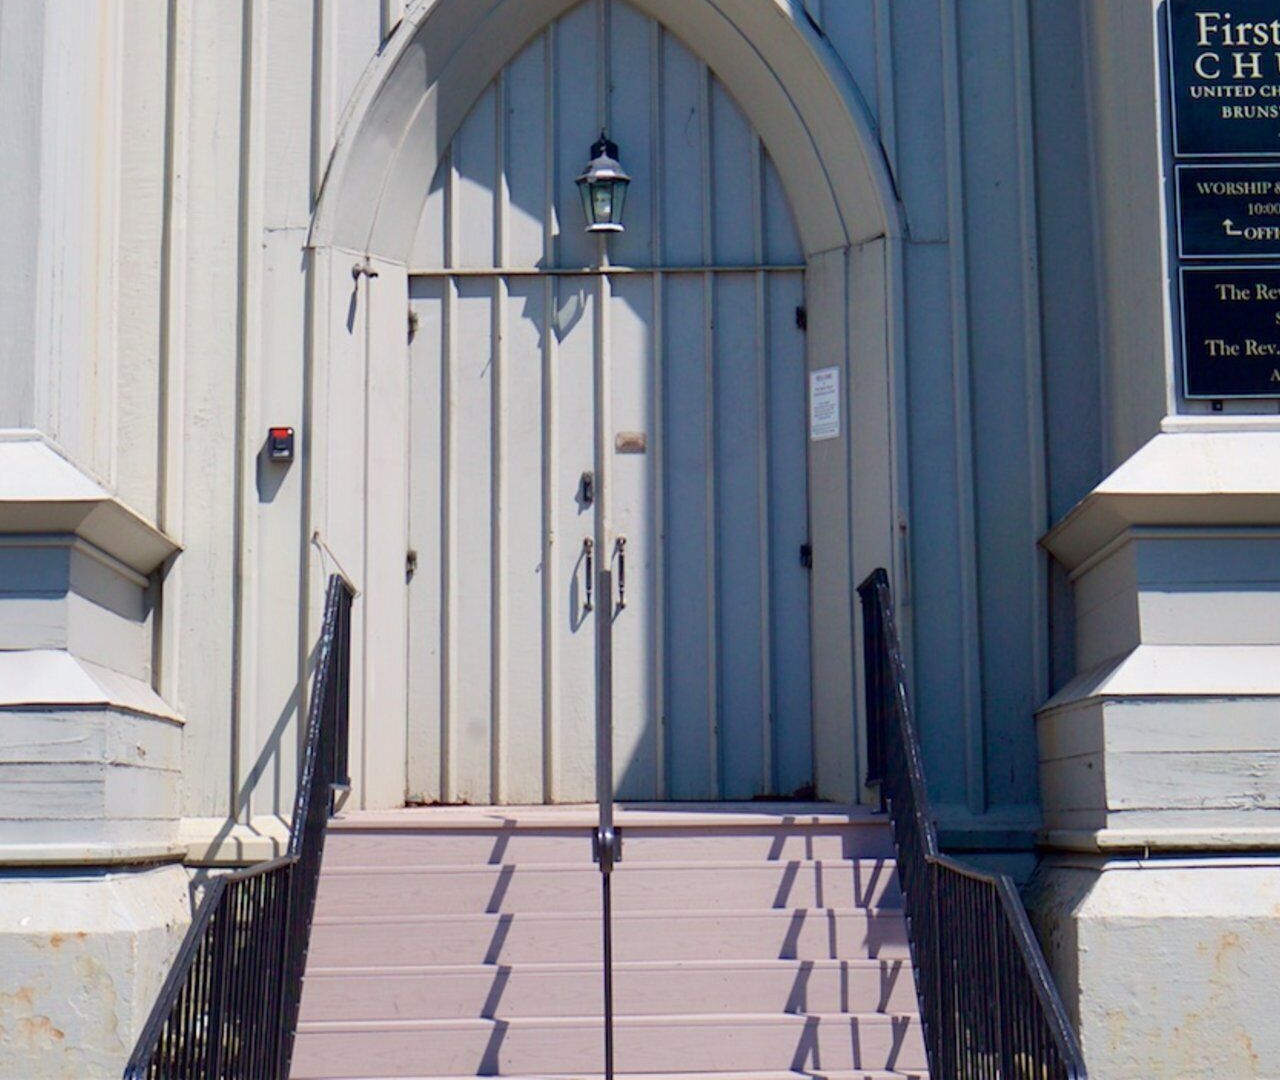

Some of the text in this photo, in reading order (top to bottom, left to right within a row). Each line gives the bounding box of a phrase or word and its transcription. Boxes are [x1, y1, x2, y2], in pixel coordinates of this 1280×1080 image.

[1190, 85, 1256, 99] UNITED
[1196, 181, 1272, 195] WORSHIP
[1215, 283, 1251, 301] The
[1204, 339, 1240, 356] The
[1245, 339, 1280, 356] Rev.
